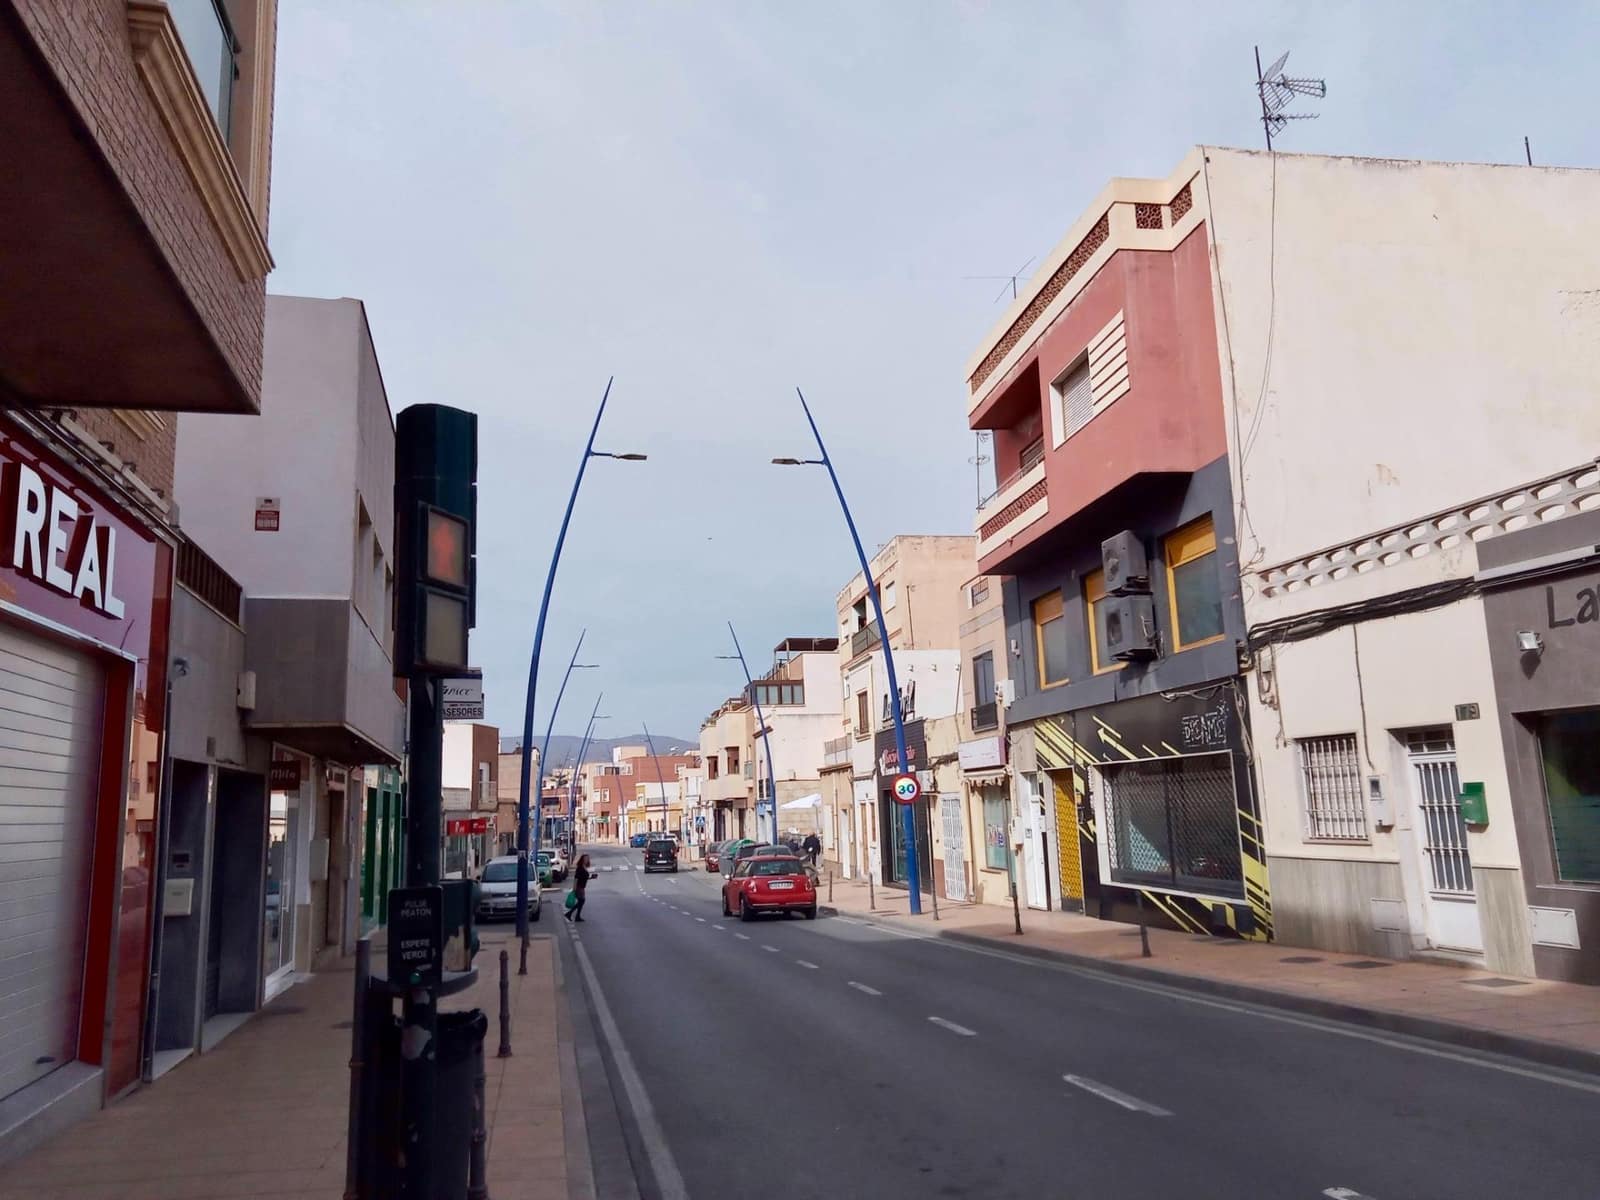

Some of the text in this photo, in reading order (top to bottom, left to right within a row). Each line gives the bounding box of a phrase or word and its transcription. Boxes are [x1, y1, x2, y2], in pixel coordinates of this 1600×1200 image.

[14, 462, 125, 620] REAL
[1546, 584, 1600, 629] La
[898, 783, 915, 795] 30
[401, 939, 430, 949] ESPERE
[402, 950, 427, 960] VERDE
